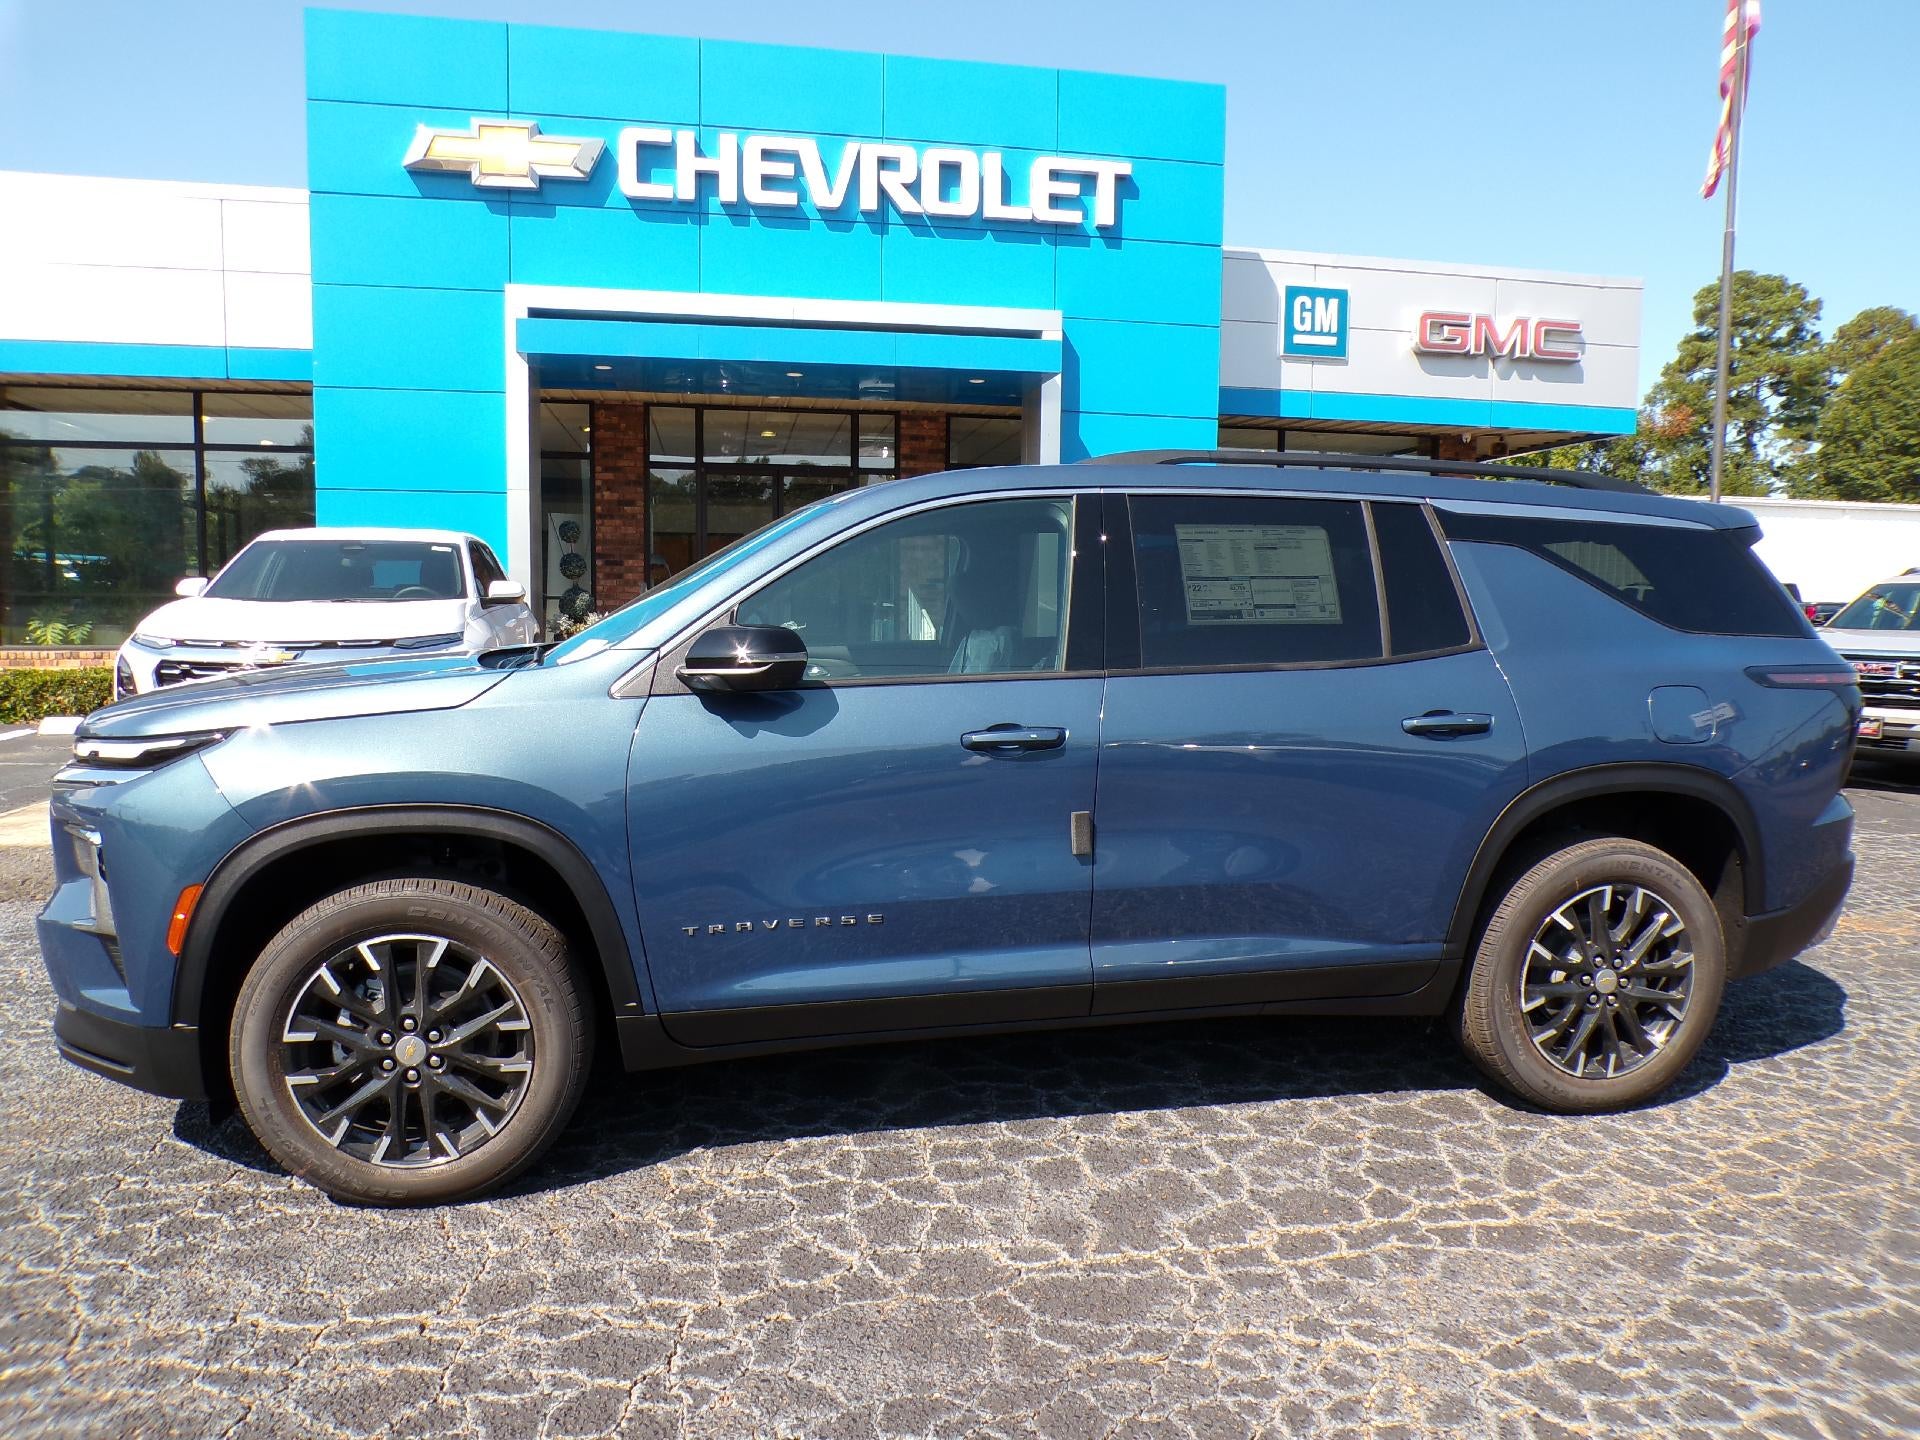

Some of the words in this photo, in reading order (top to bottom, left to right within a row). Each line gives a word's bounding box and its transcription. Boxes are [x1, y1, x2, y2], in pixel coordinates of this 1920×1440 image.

[616, 126, 1133, 228] CHEVROLET
[1293, 295, 1339, 334] GM
[1416, 309, 1584, 361] GMC
[681, 913, 884, 937] TRAVERSE
